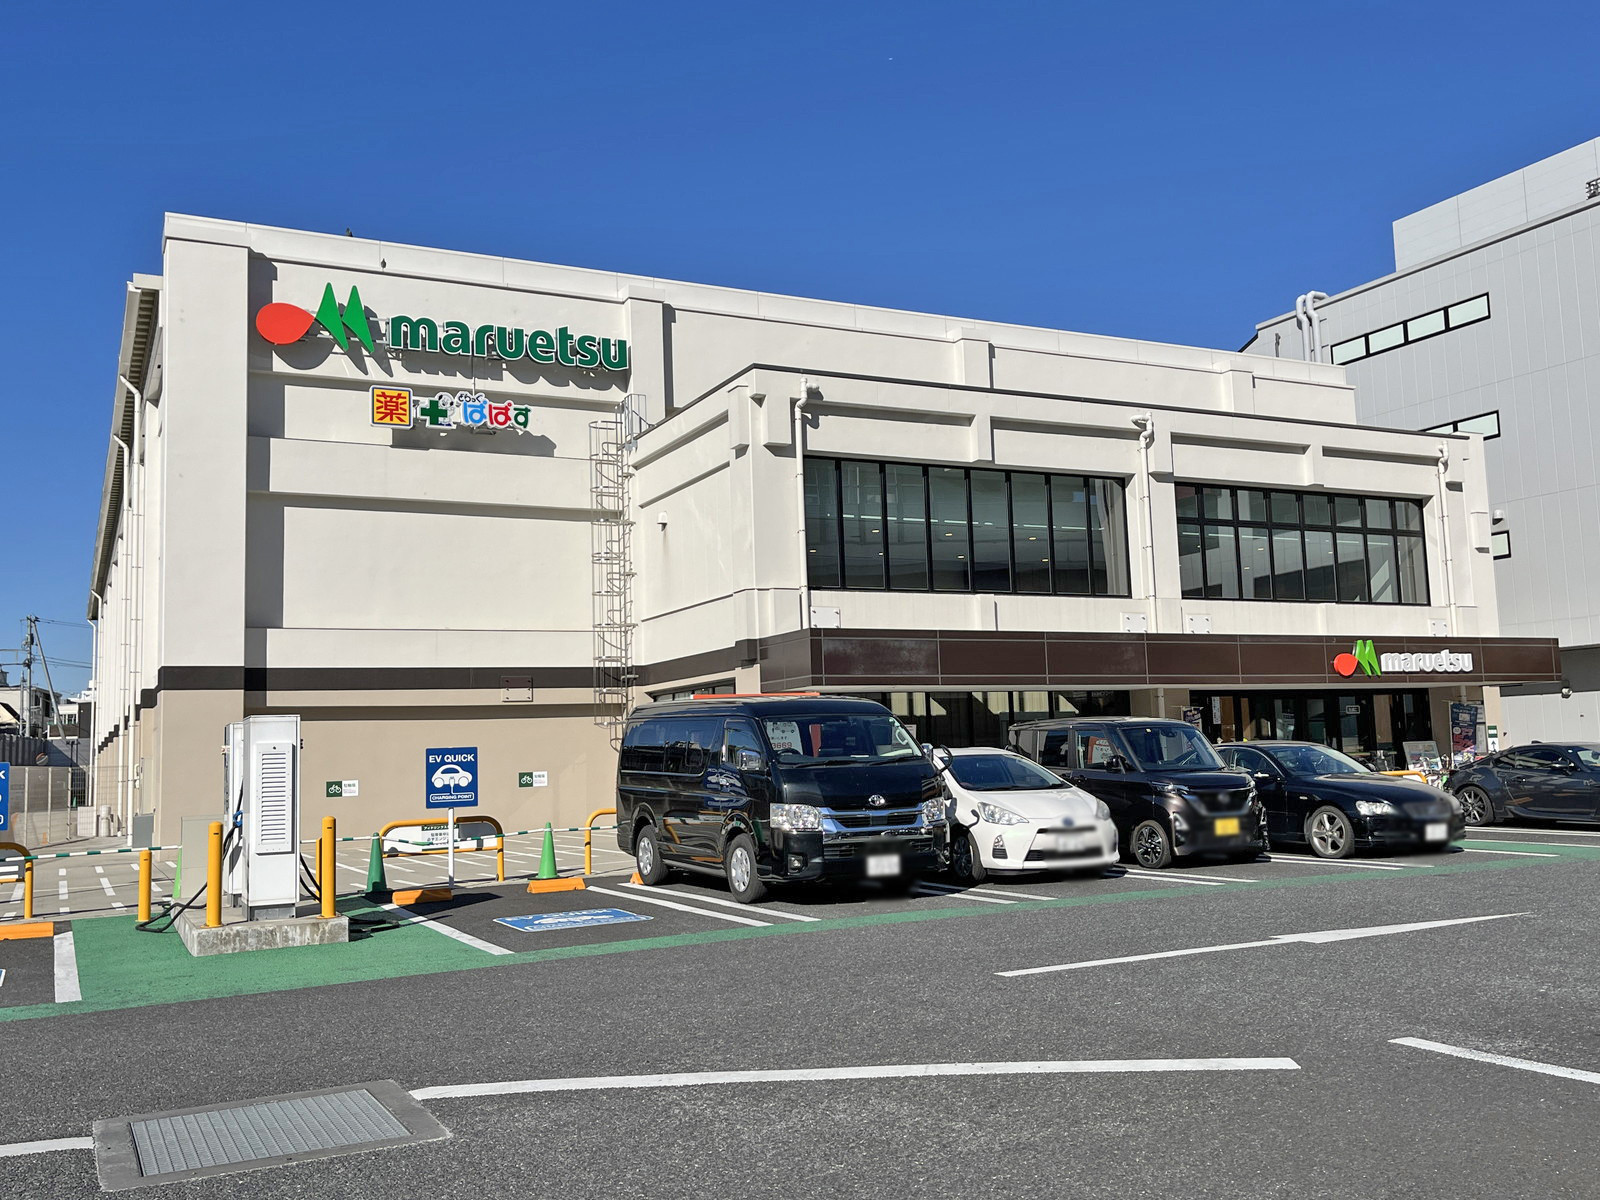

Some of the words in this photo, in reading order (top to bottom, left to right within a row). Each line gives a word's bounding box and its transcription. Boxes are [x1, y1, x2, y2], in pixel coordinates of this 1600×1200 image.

[389, 314, 628, 371] maruetsu
[376, 392, 408, 423] 薬
[463, 400, 531, 428] ぱぱす
[1381, 649, 1473, 672] maruetsu
[429, 755, 442, 763] EV
[444, 754, 475, 762] QUICK
